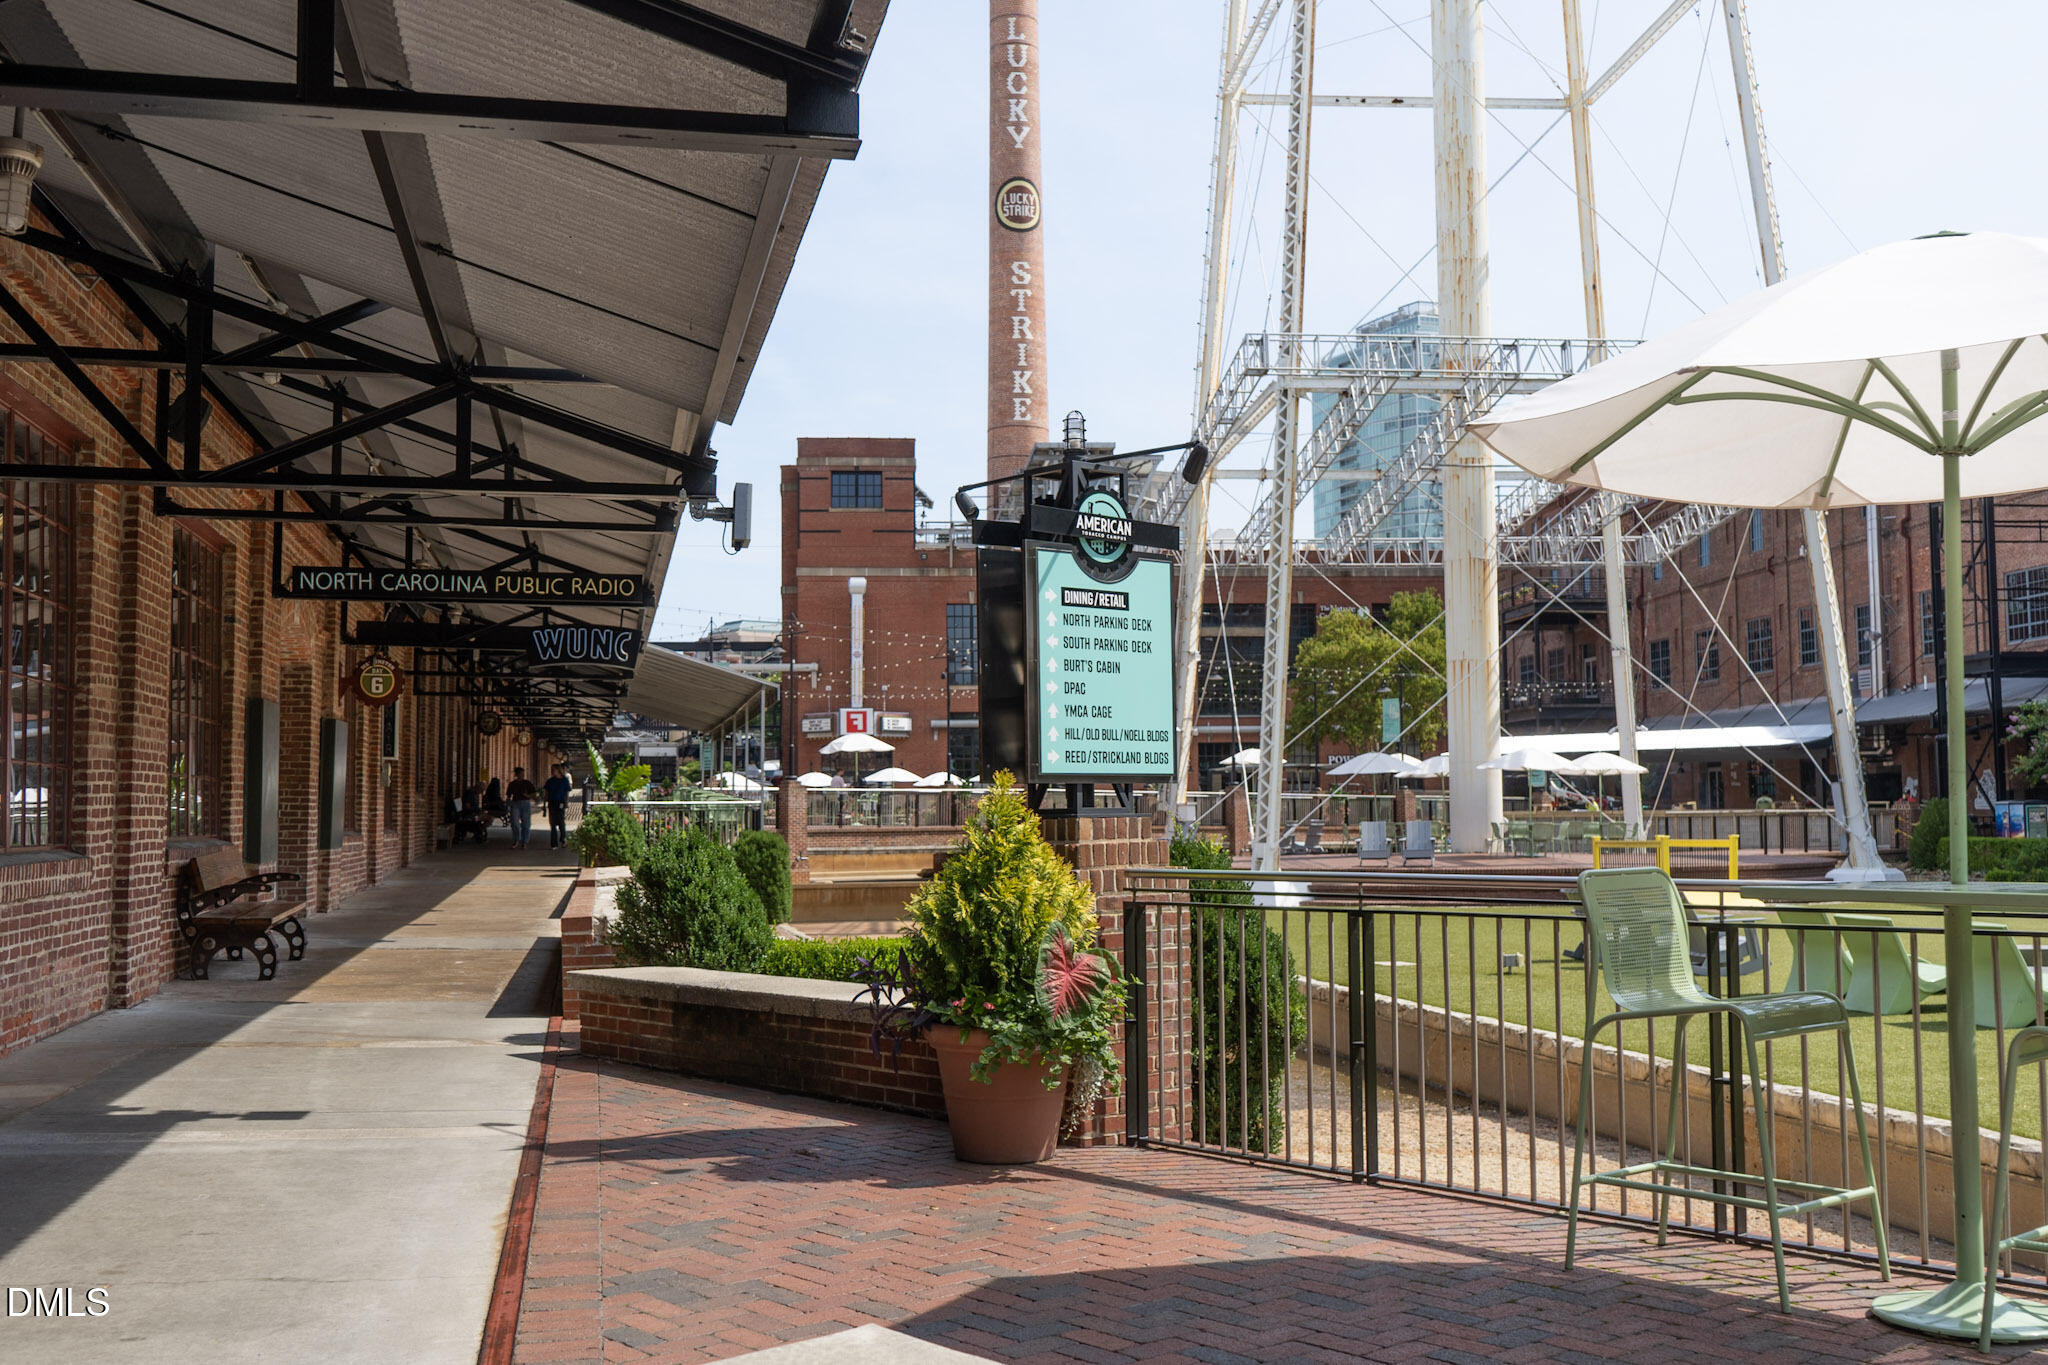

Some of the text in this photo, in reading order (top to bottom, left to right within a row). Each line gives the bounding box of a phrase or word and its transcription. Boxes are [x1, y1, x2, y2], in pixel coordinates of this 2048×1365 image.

[1006, 17, 1031, 149] LUCKY
[1003, 193, 1035, 205] LUCKY
[1003, 204, 1036, 218] STRIKE
[1010, 261, 1034, 421] STRIKE
[1076, 514, 1132, 537] AMERICAN
[1082, 530, 1127, 541] TOBACCO CAMPUS
[300, 571, 635, 597] NORTH CAROLINA PUBLIC RADIO
[1064, 590, 1127, 608] DINING/RETAIL
[1063, 613, 1152, 632] NORTH PARKING DECK
[532, 627, 633, 662] WUNC
[1063, 636, 1152, 653] SOUTH PARKING DECK
[1064, 659, 1121, 674] BURT'S CABIN
[371, 677, 384, 693] 6
[1064, 682, 1086, 695] DPAC
[1064, 704, 1112, 718] YMCA CAGE
[1065, 728, 1169, 742] HILL/OLD BULL/NOELL BLDGS
[1065, 750, 1169, 764] REED/STRICKLAND BLDGS
